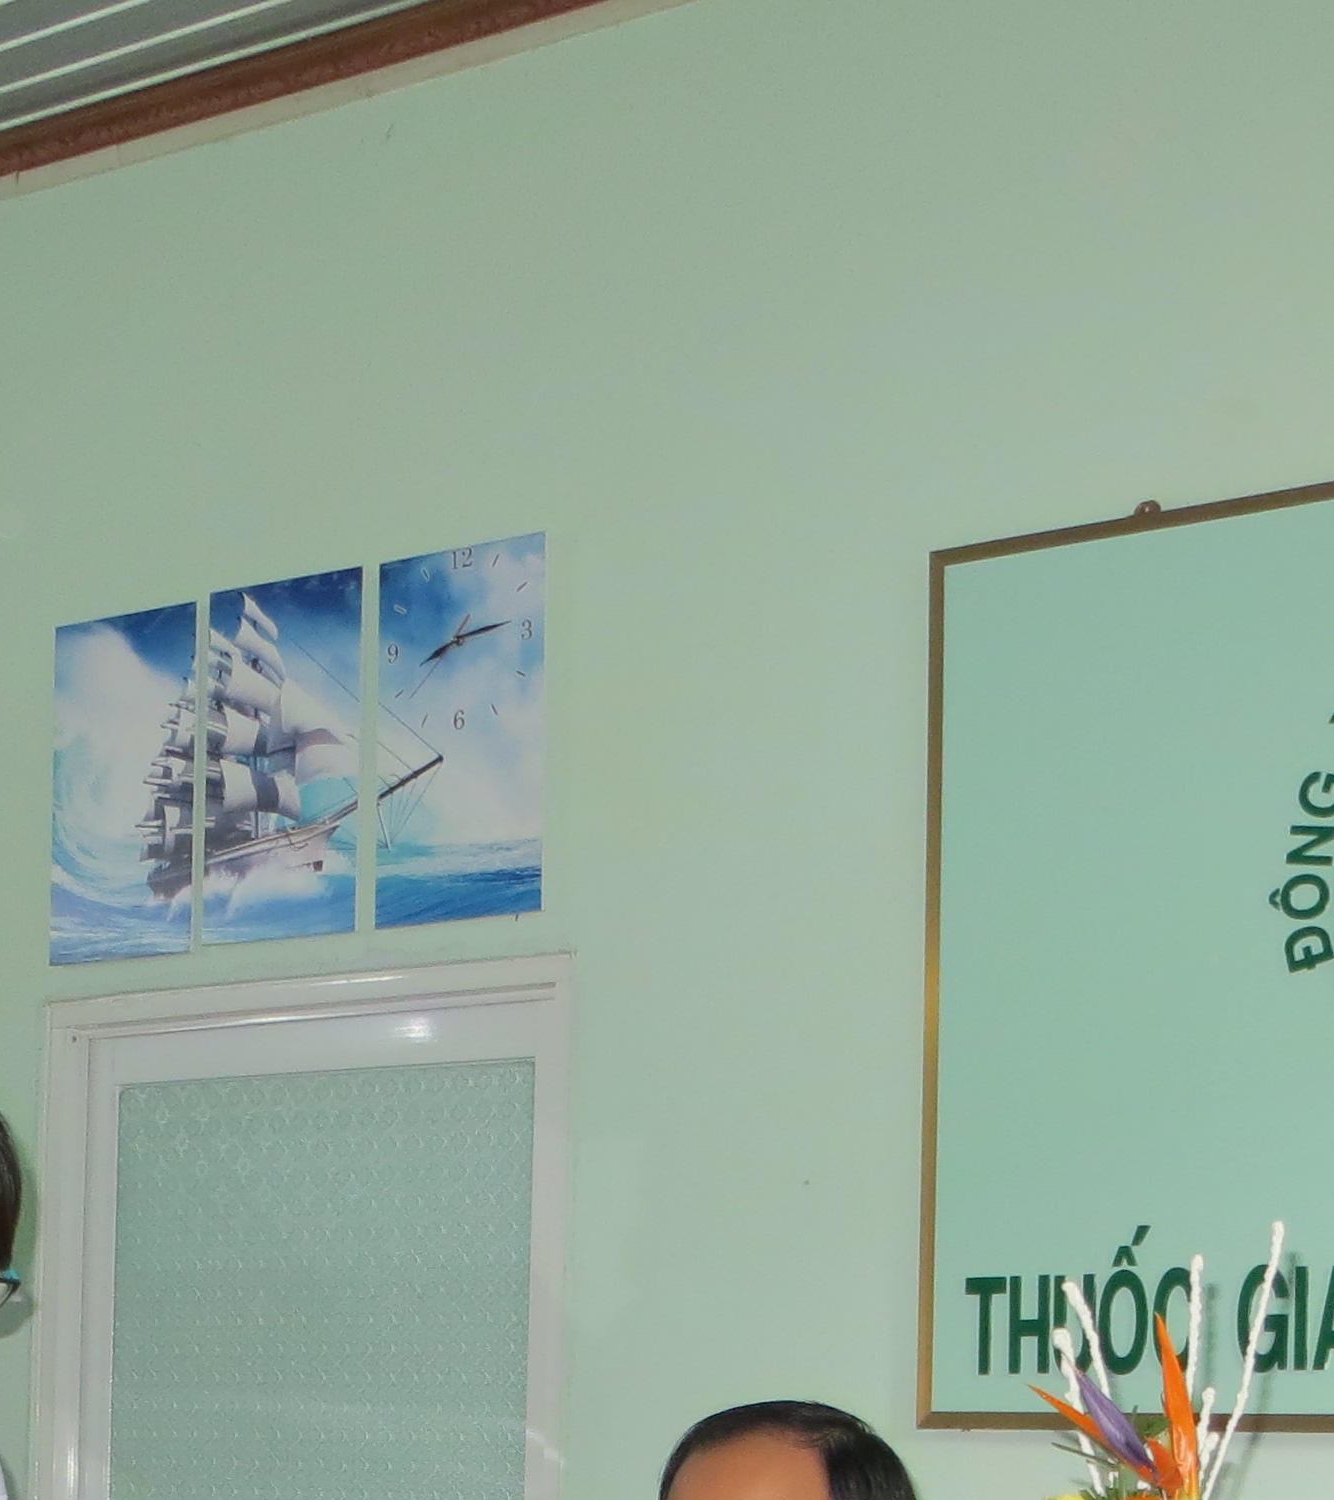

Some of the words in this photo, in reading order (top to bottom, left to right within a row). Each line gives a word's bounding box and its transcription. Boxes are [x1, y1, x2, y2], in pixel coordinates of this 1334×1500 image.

[451, 547, 473, 570] 12
[521, 619, 533, 640] 3
[387, 644, 399, 663] 9
[453, 709, 465, 730] 6
[965, 1225, 1194, 1376] THUỐC
